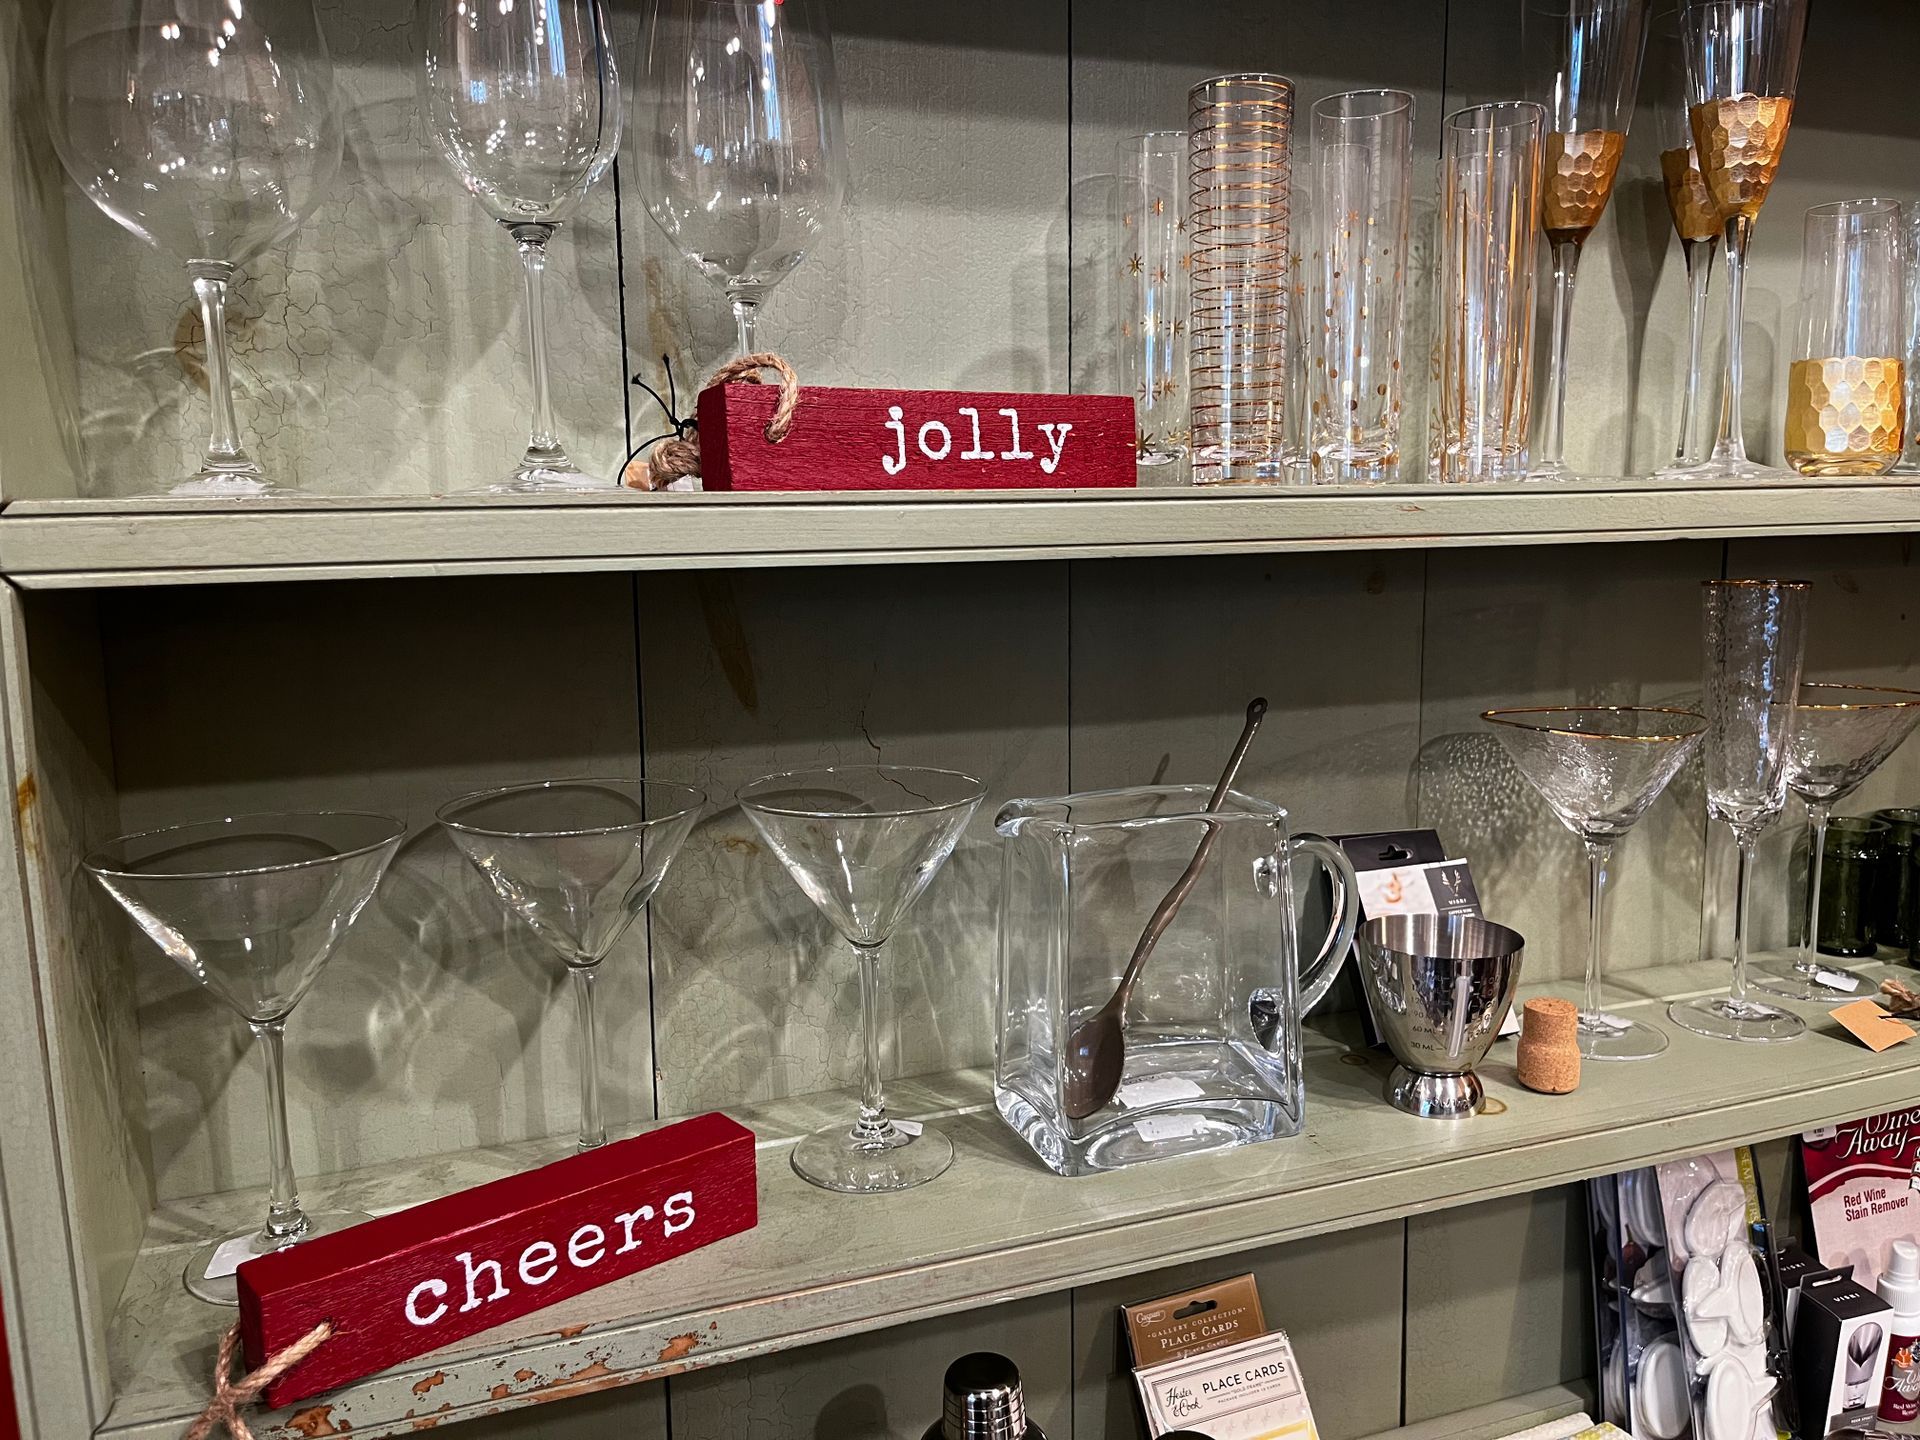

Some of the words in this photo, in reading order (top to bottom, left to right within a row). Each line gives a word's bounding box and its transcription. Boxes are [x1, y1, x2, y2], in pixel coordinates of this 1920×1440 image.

[881, 405, 1074, 476] jolly
[1422, 1043, 1435, 1051] ML
[1865, 1108, 1920, 1135] Wine
[1835, 1126, 1909, 1159] Away
[1844, 1192, 1862, 1208] Red
[1863, 1188, 1887, 1203] Wine
[1845, 1206, 1869, 1222] Stain
[1871, 1196, 1909, 1215] Remover
[404, 1190, 697, 1326] cheers
[1191, 1308, 1243, 1326] COLLECTION
[1160, 1331, 1197, 1348] PLACE
[1202, 1319, 1239, 1337] CARDS
[1202, 1374, 1242, 1394] PLACE
[1245, 1362, 1285, 1381] CARDS
[1166, 1386, 1193, 1407] Hester
